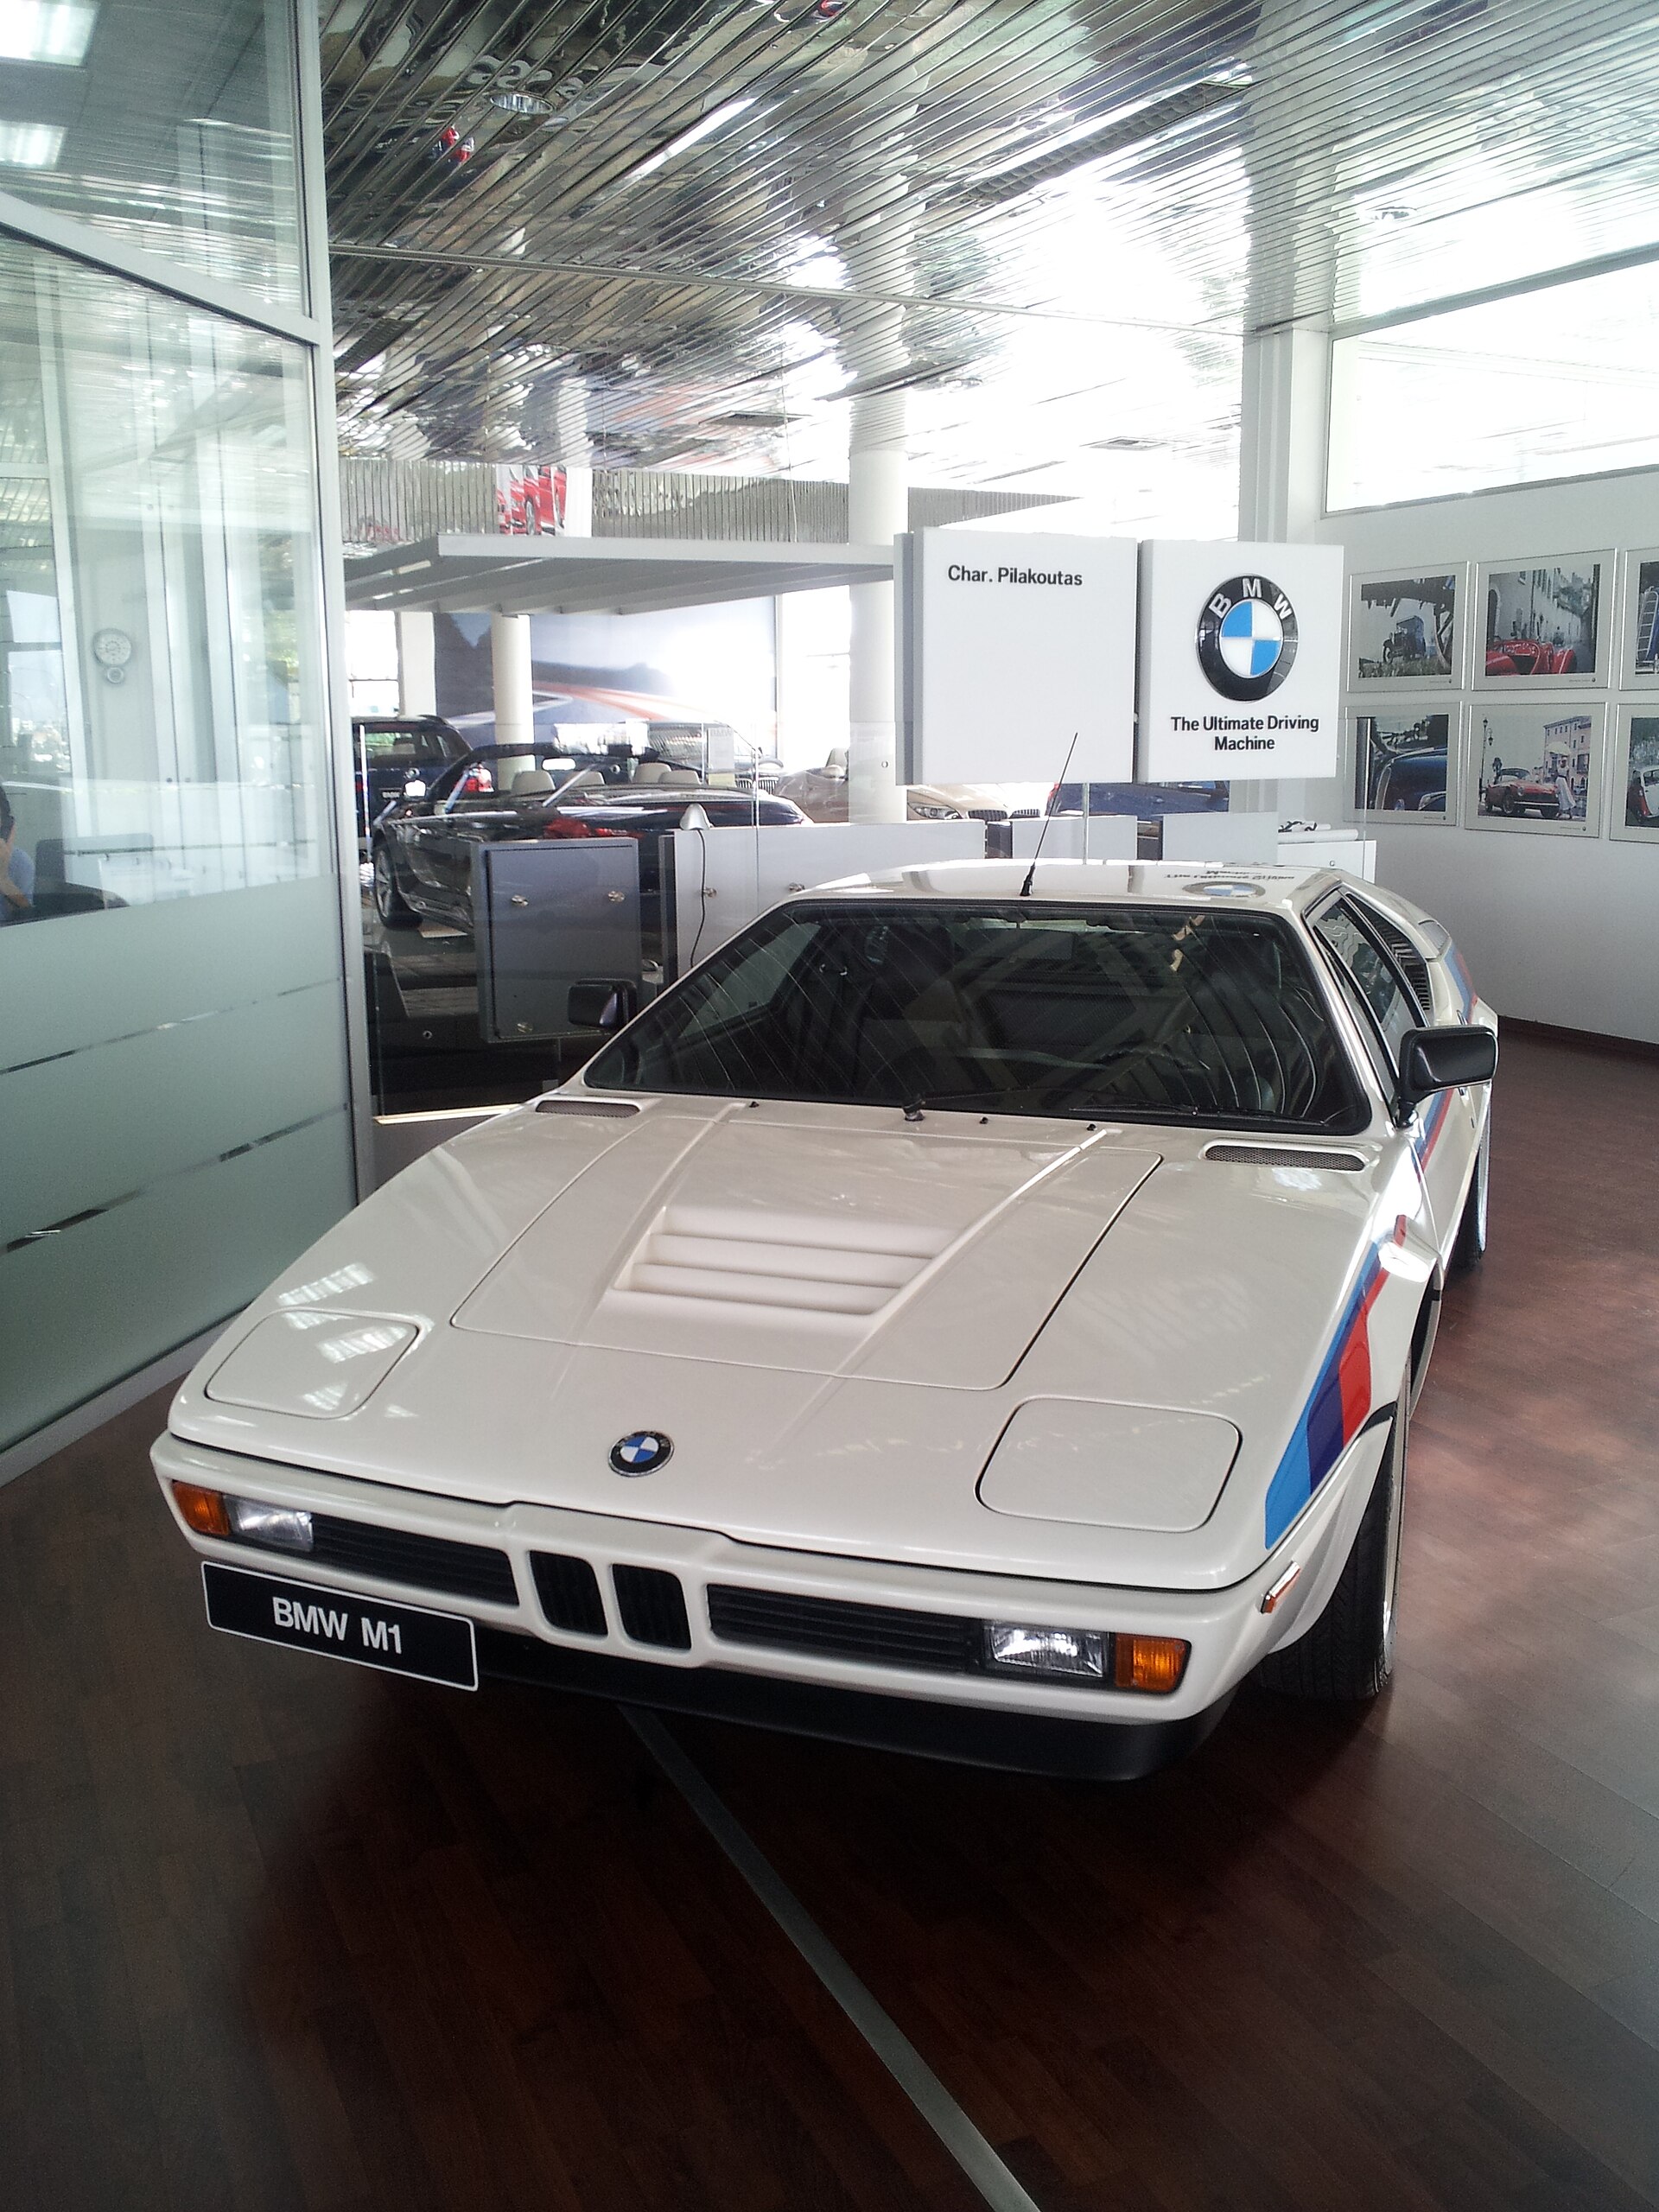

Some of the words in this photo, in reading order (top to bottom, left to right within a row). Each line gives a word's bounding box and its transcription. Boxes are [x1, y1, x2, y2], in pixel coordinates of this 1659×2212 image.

[948, 564, 993, 582] Char.
[997, 567, 1083, 586] Pilakoutas
[1208, 577, 1294, 620] BMW
[1171, 716, 1199, 731] The
[1203, 715, 1264, 731] Ultimate
[1268, 715, 1319, 733] Driving
[1214, 735, 1275, 751] Machine
[272, 1596, 348, 1642] BMW
[361, 1617, 402, 1655] M1
